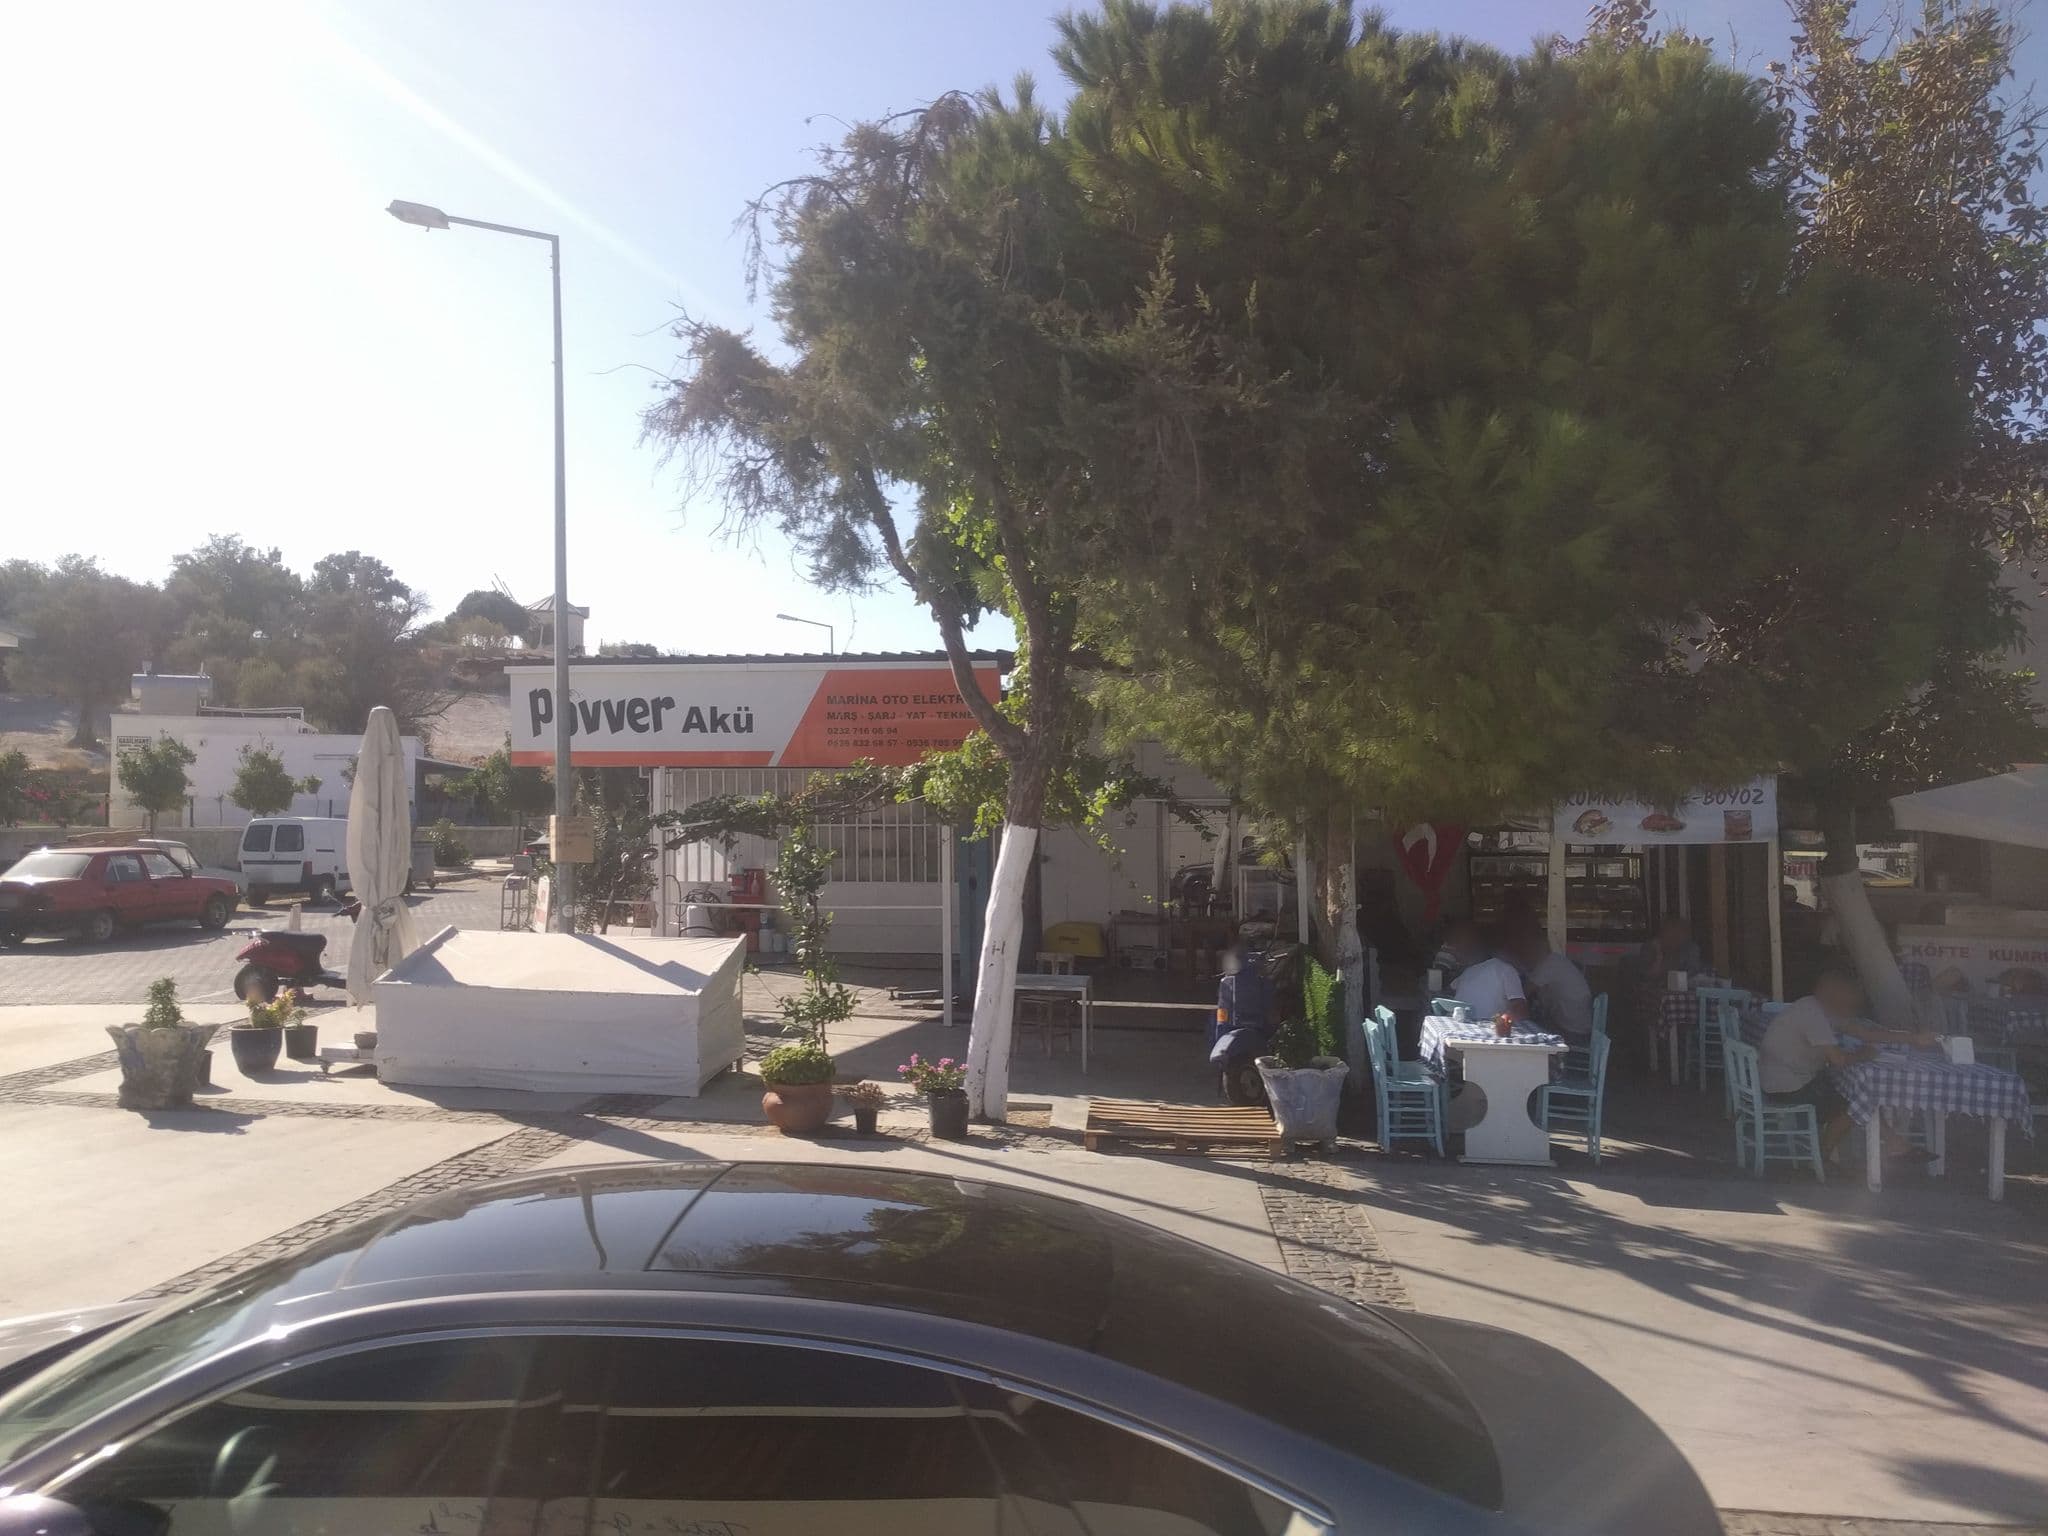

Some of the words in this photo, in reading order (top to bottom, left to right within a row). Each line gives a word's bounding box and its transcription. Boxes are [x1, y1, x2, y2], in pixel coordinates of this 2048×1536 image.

[882, 694, 909, 705] OTO
[681, 705, 755, 734] Akü
[906, 711, 927, 720] YAT
[827, 727, 851, 735] 0232
[1911, 942, 1969, 959] KÖFTE
